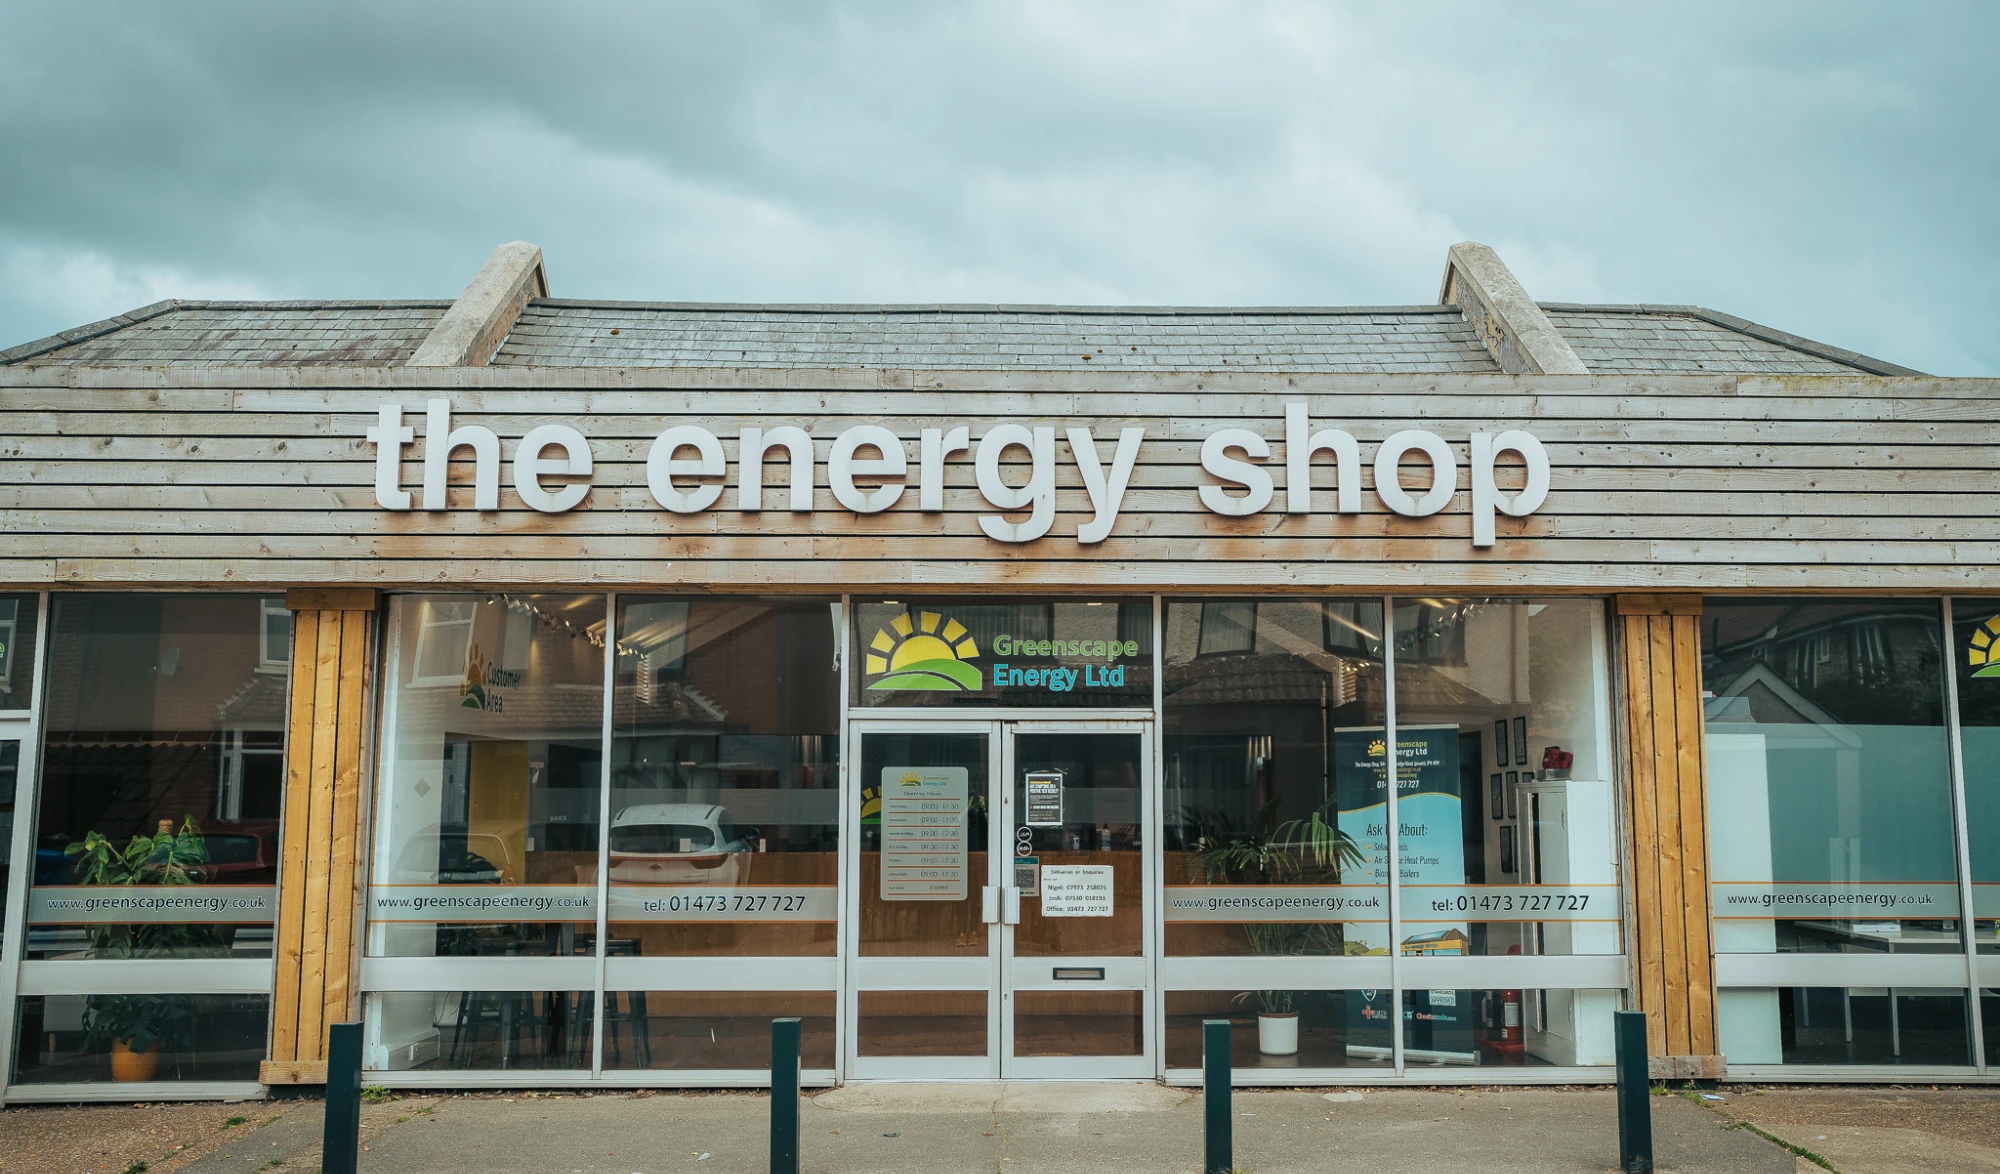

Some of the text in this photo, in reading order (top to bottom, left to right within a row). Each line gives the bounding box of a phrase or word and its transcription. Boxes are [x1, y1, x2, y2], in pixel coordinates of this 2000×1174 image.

[367, 398, 1550, 547] the energy shop
[993, 635, 1138, 661] Greenscape
[487, 661, 521, 690] Customer
[993, 664, 1124, 691] Energy Ltd
[486, 688, 502, 713] Area
[1396, 748, 1414, 757] nergy
[1366, 823, 1383, 836] Ask
[1399, 823, 1428, 836] About:
[1374, 843, 1387, 851] Sola
[1374, 856, 1383, 864] Air
[1404, 856, 1418, 864] Heat
[1419, 856, 1439, 866] Pumps
[1400, 869, 1420, 878] Boilers
[48, 896, 266, 912] www.greenscapeenergy.co.uk
[377, 896, 590, 910] www.greenscapeenergy.co.uk
[643, 895, 806, 912] tel: 01473 727 727
[1172, 896, 1380, 910] www.greenscapeenergy.co.uk
[1432, 895, 1590, 911] tel: 01473 727 727
[1727, 893, 1933, 908] www.greenscapeenergy.co.uk
